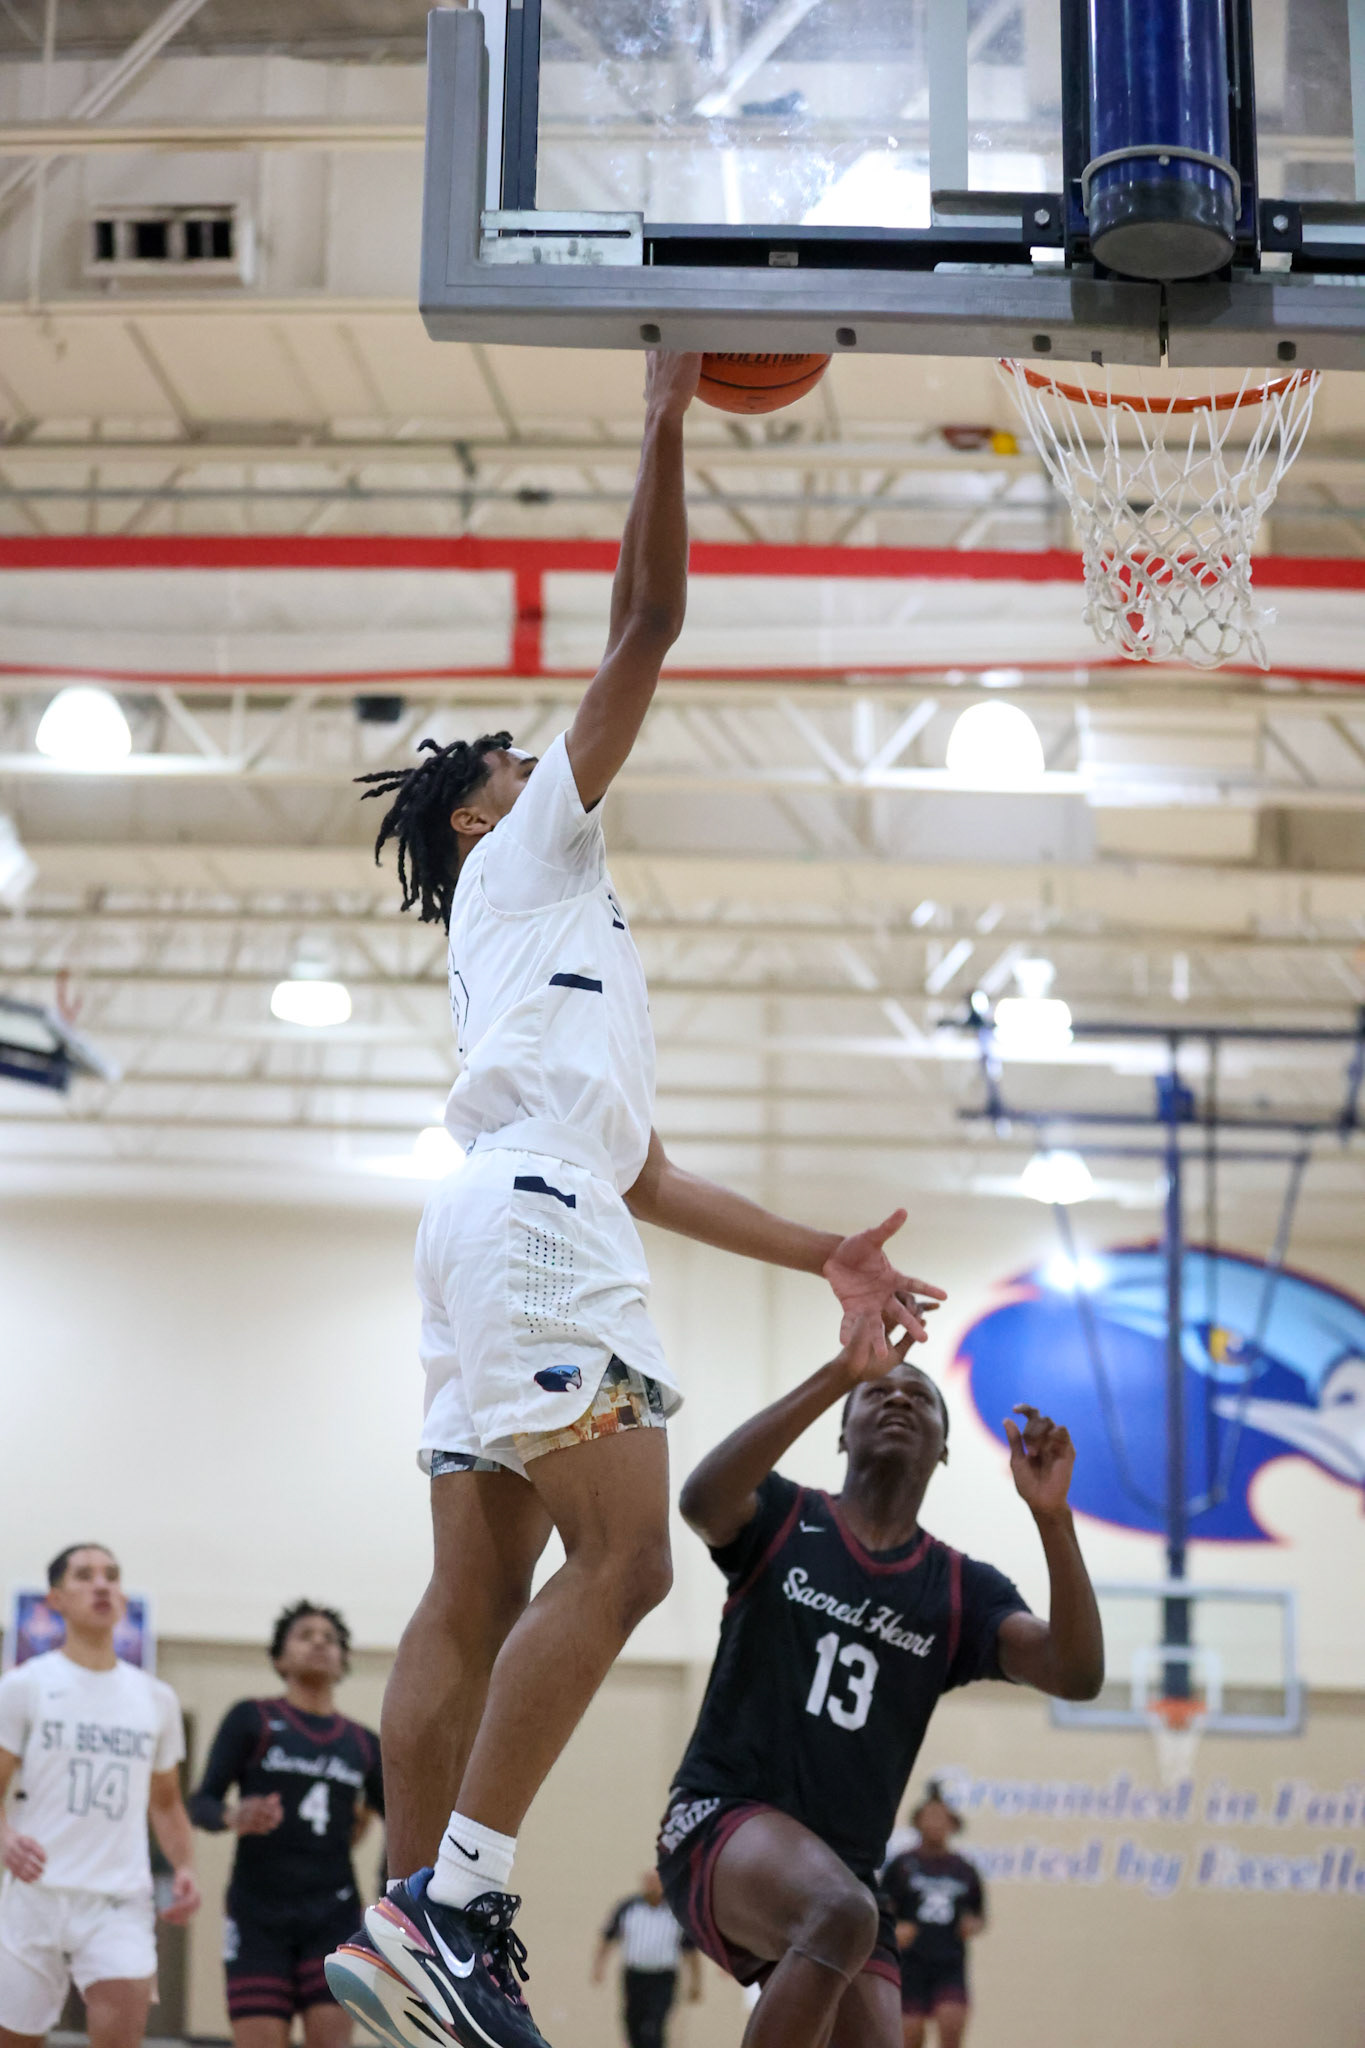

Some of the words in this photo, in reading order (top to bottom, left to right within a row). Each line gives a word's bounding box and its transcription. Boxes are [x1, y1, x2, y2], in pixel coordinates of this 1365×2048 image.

[782, 1566, 872, 1628] Sacred
[864, 1605, 936, 1659] Heart
[805, 1631, 880, 1731] 13
[66, 1757, 130, 1821] 14
[298, 1781, 331, 1836] 4
[1111, 1838, 1192, 1897] by
